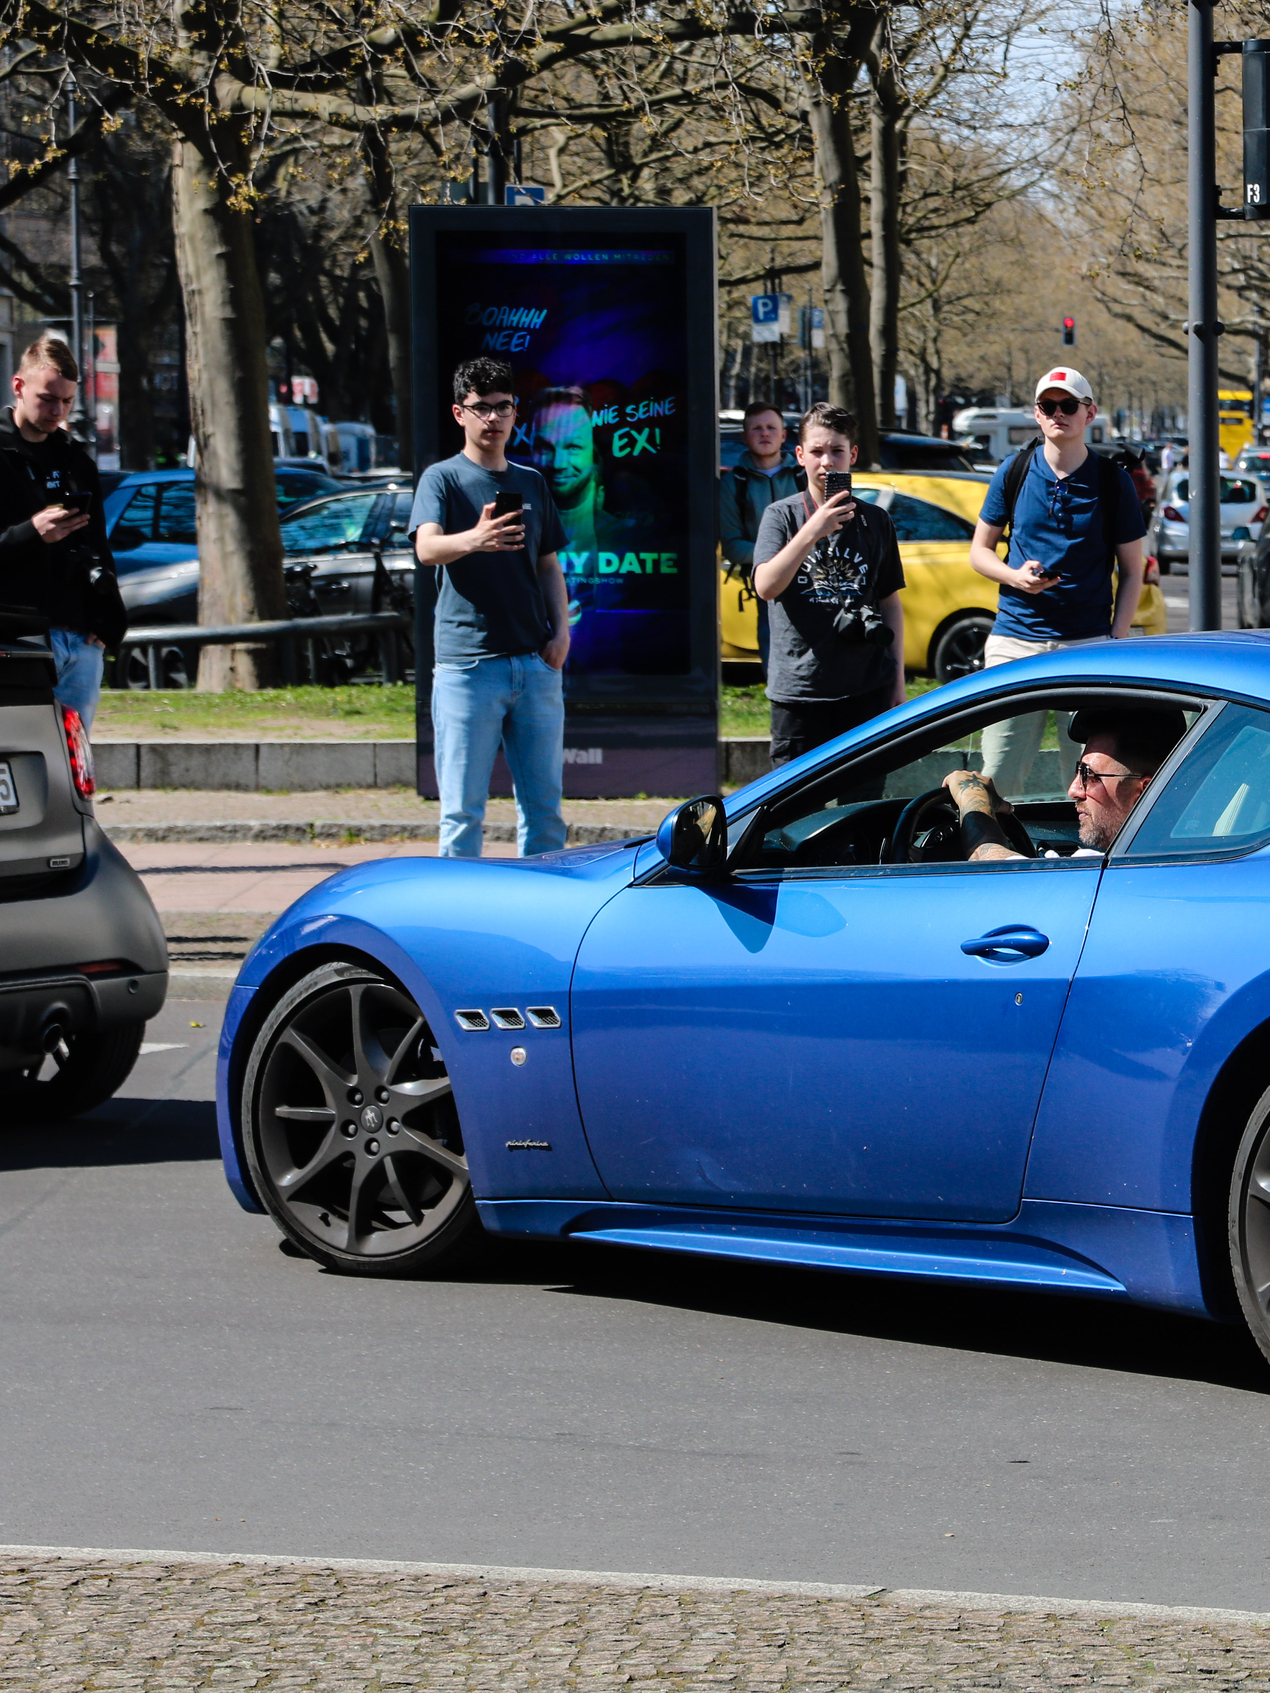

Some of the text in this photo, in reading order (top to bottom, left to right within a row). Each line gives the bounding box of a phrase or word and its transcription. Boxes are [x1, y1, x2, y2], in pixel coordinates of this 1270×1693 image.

[1246, 184, 1261, 204] F3
[563, 253, 609, 261] WOLLEN
[757, 298, 773, 320] P
[482, 331, 530, 352] NEE!
[625, 397, 676, 422] SEINE
[612, 427, 662, 458] EX!
[598, 552, 678, 574] DATE
